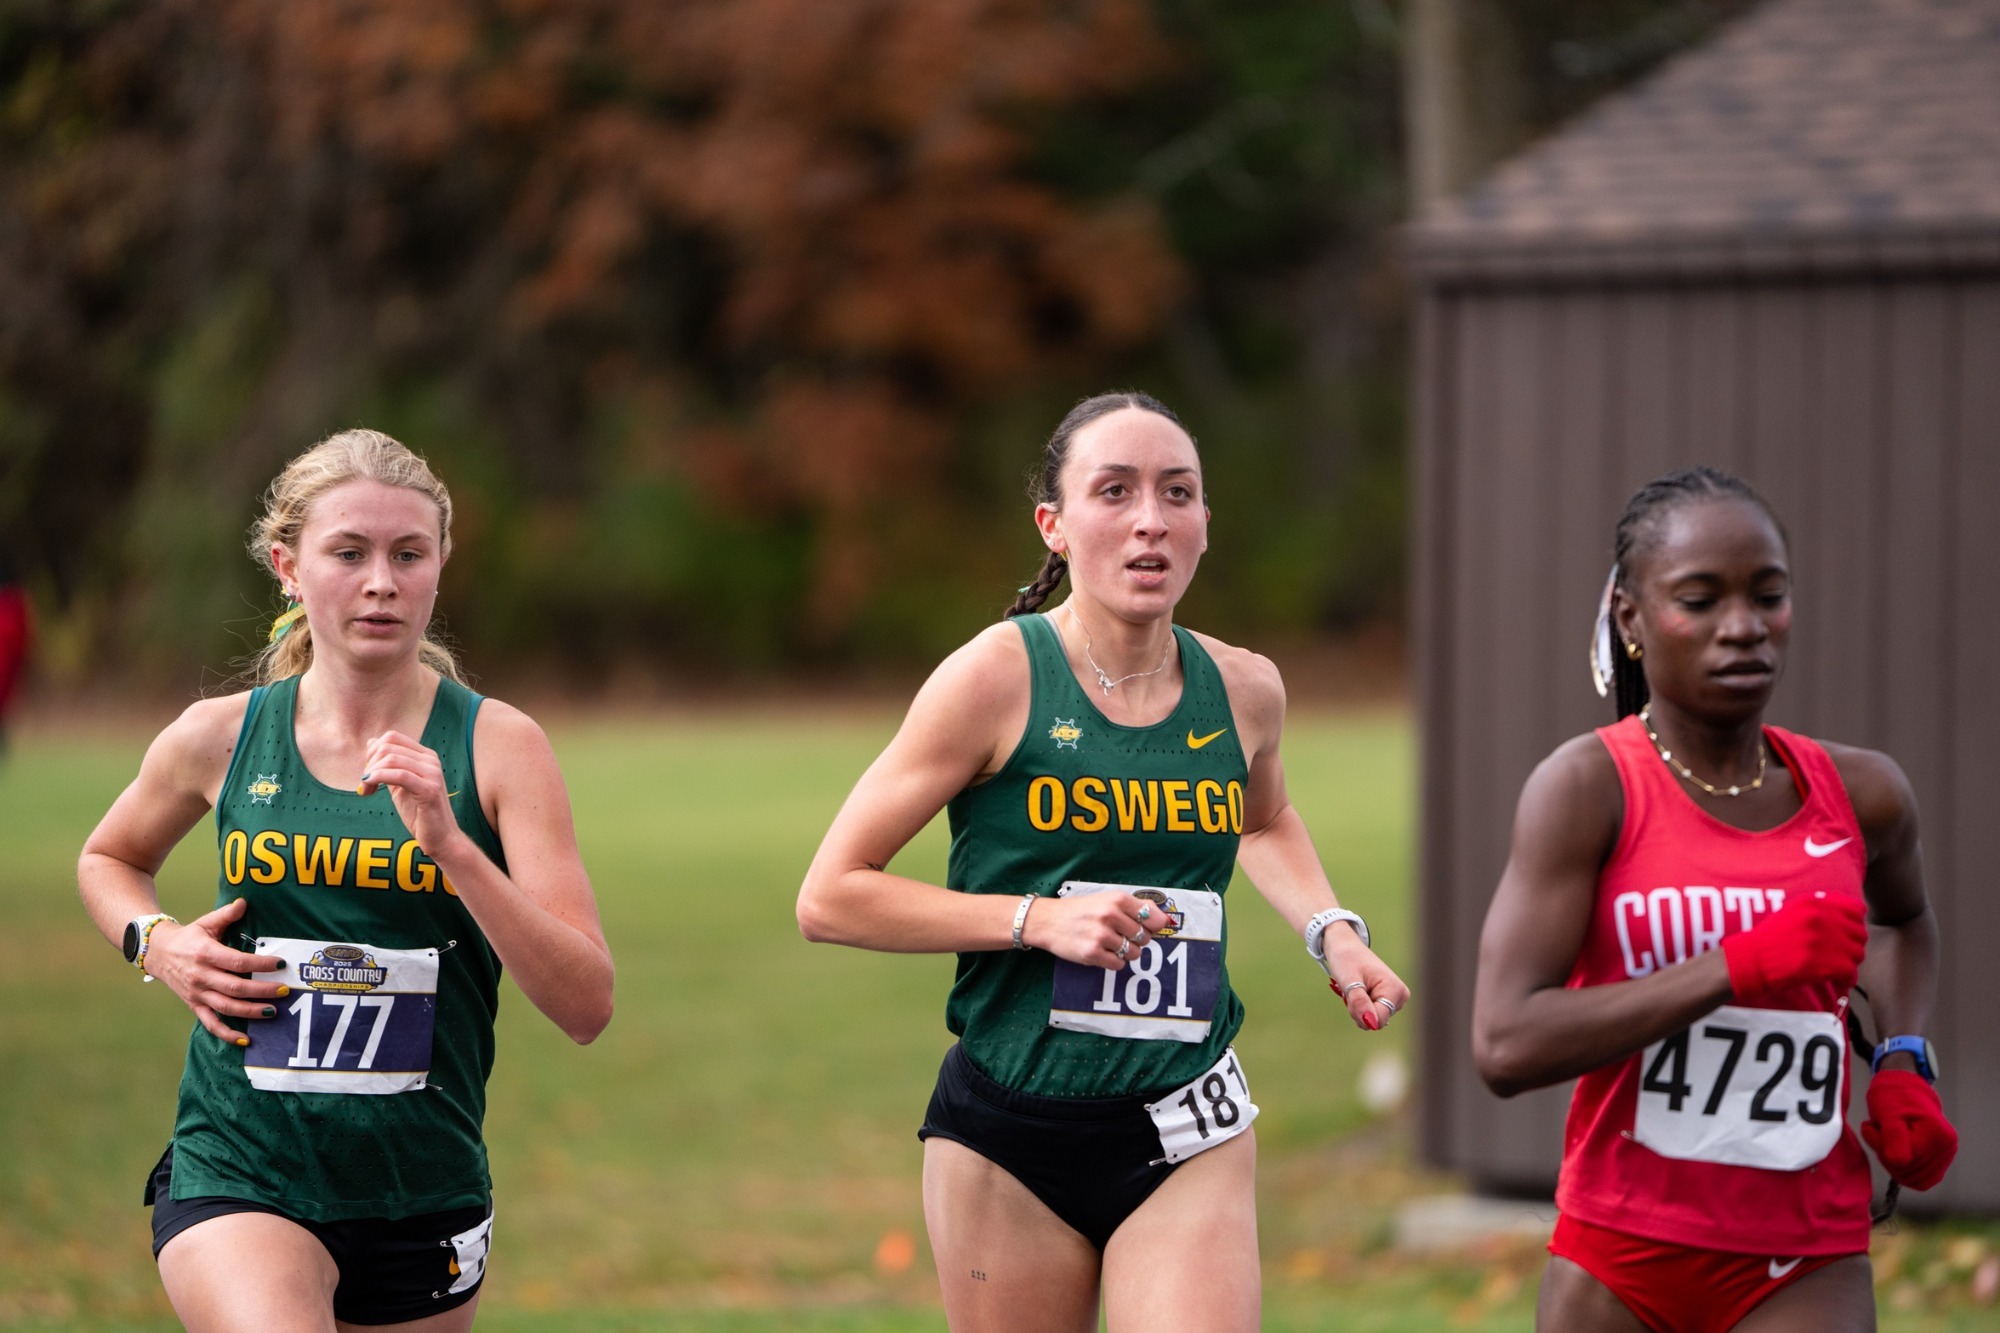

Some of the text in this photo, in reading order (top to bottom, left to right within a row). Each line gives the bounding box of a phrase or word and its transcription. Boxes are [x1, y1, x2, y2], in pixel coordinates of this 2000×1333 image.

[1027, 775, 1244, 835] OSWEGO
[303, 965, 382, 983] CROSS COUNTRY
[1093, 940, 1192, 1017] 181
[288, 992, 395, 1069] 177
[1178, 1055, 1249, 1140] 181
[1642, 1024, 1842, 1126] 4729
